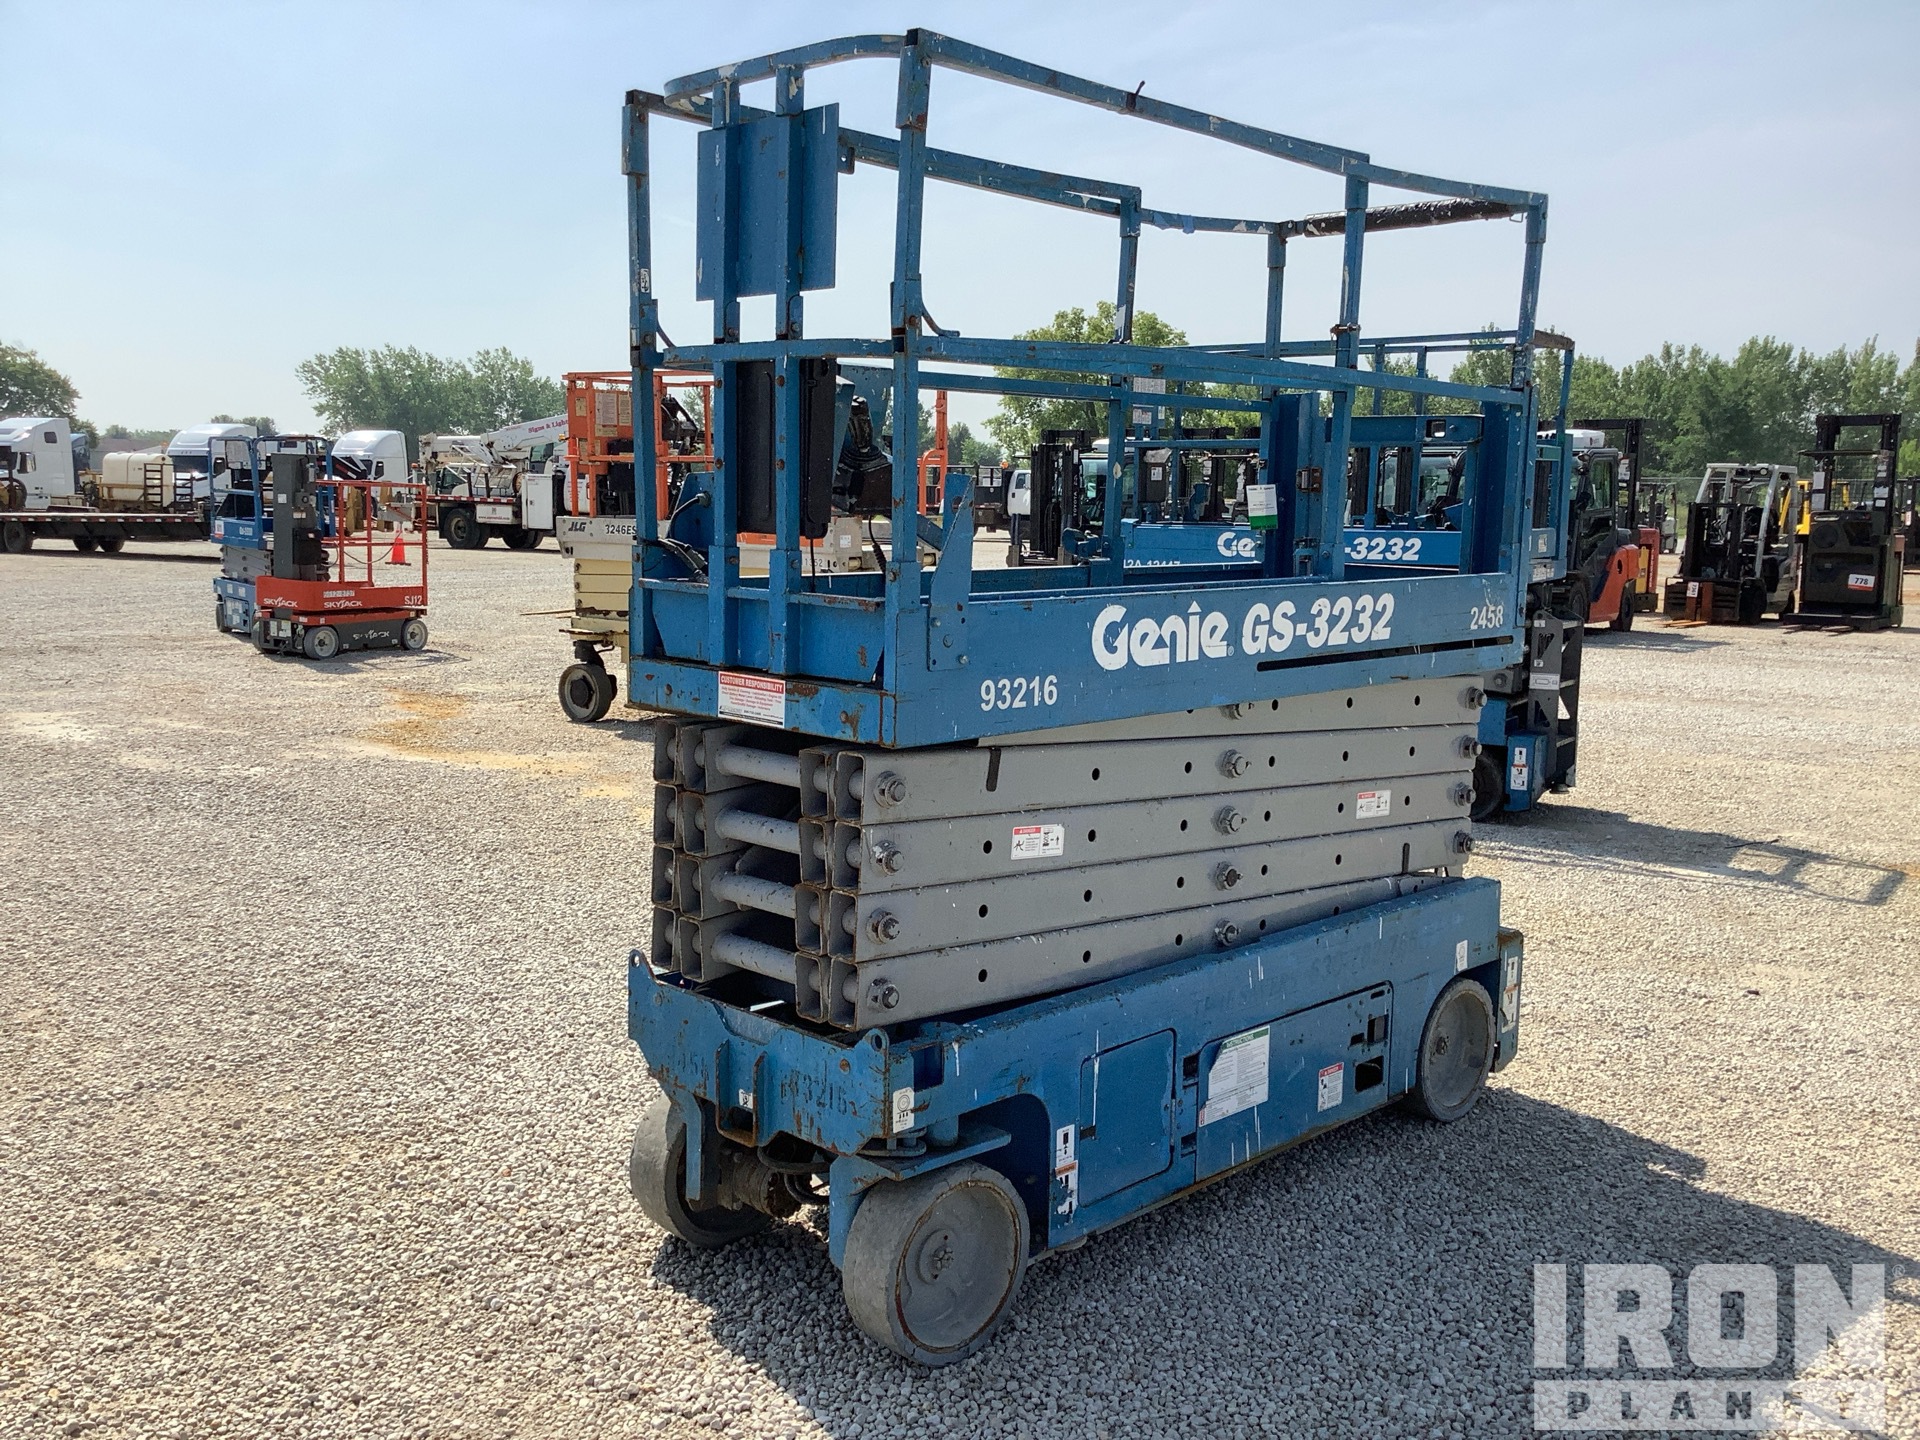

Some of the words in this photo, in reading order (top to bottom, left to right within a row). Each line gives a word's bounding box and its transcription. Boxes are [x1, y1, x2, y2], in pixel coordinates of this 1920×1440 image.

[552, 419, 568, 427] Ligh
[568, 521, 586, 532] JLG
[605, 524, 637, 535] 3246ES
[1344, 536, 1422, 561] -3232
[1854, 577, 1869, 586] 778
[263, 597, 298, 608] SKYJACK
[323, 599, 363, 609] SKYJACK
[404, 595, 423, 605] SJ12
[1470, 606, 1504, 631] 2458
[1091, 600, 1229, 671] Genie
[1242, 592, 1395, 655] GS-3232
[720, 675, 745, 686] CUSTOMER
[745, 678, 783, 692] RESPONSIBILITY
[980, 675, 1058, 712] 93216
